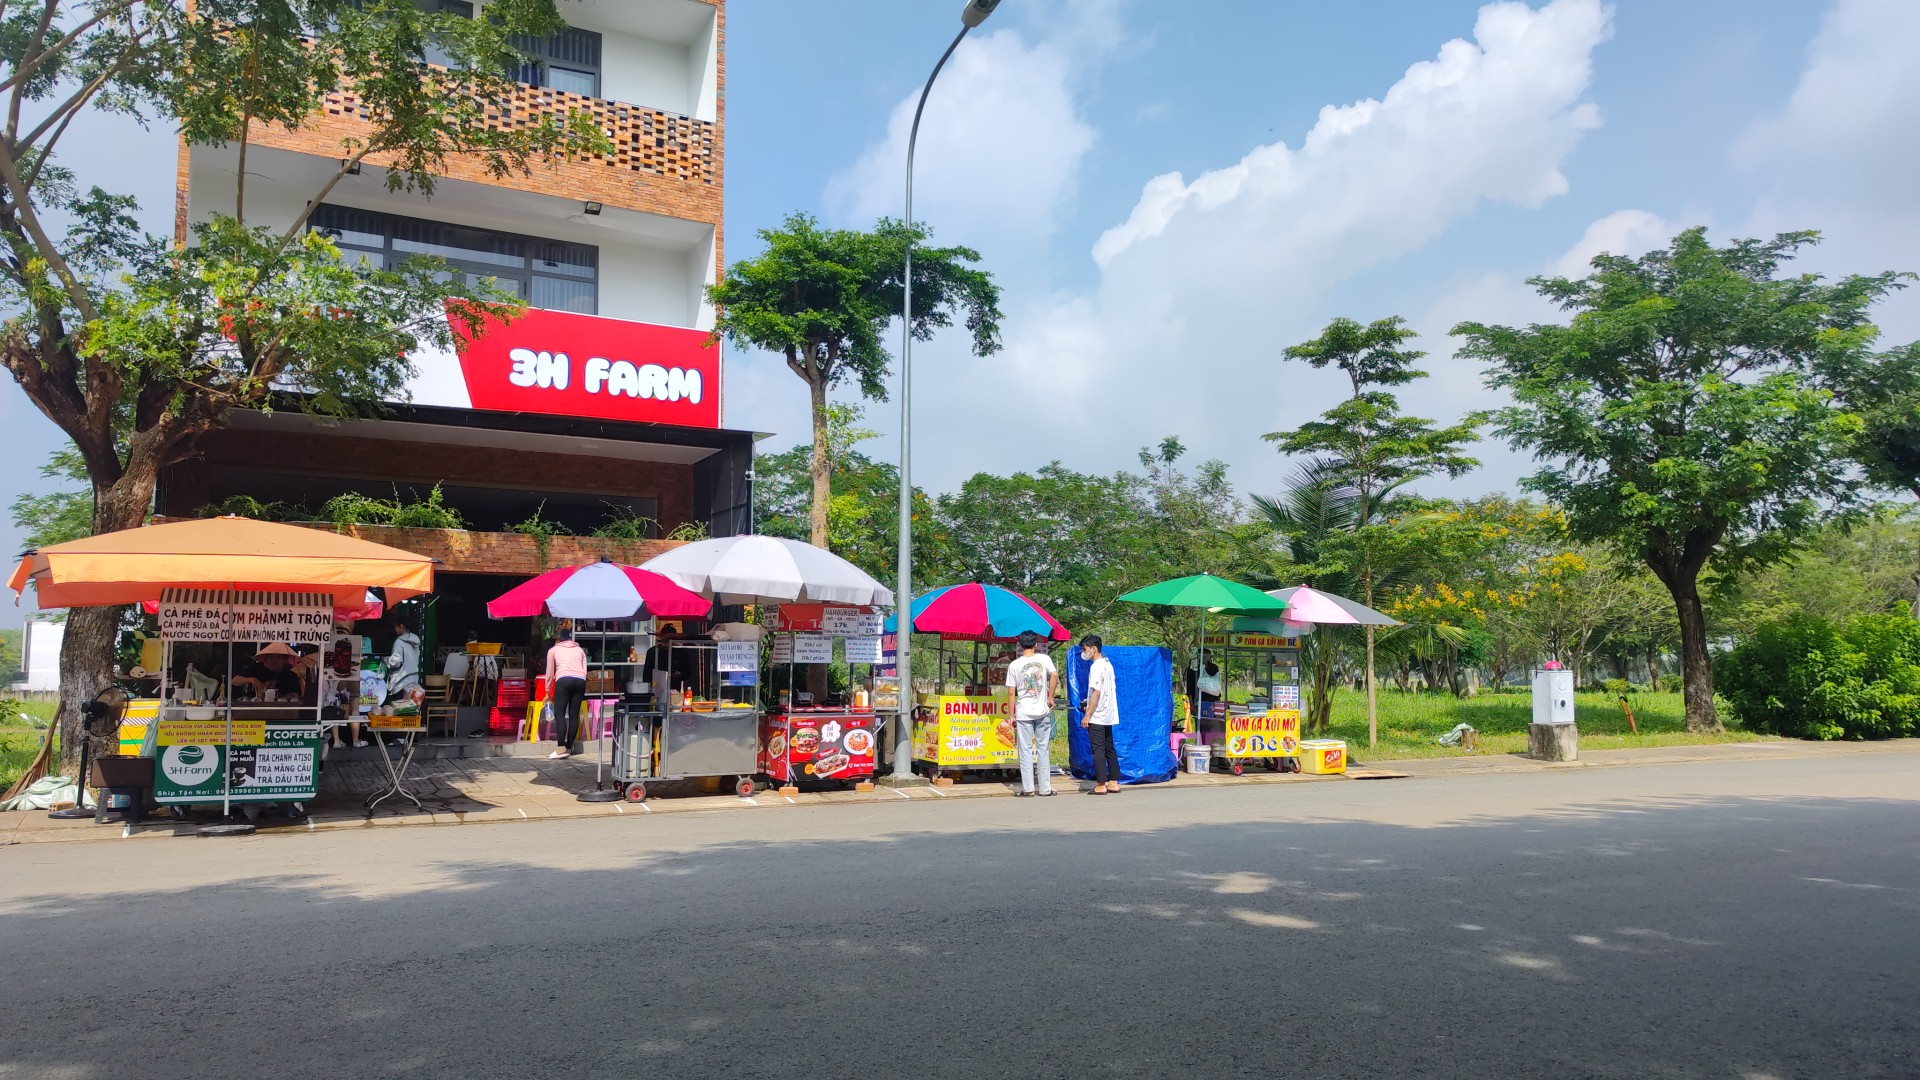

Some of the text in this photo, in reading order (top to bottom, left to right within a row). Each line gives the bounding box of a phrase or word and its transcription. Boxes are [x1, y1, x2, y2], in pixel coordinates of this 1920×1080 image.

[509, 348, 703, 405] 3H FARM
[164, 606, 221, 619] CÀ PHÊ ĐÁ
[249, 609, 277, 625] PHẦN
[278, 610, 331, 626] MÌ TRỘN
[163, 620, 173, 629] CÀ
[175, 620, 190, 629] PHÊ
[209, 619, 220, 630] ĐÁ
[163, 630, 219, 641] NƯỚC NGỌT
[252, 628, 276, 641] PHÒNG
[277, 629, 330, 642] MÌ TRỨNG
[945, 700, 978, 715] BÁNH
[982, 700, 997, 715] MÌ
[273, 731, 318, 739] COFFEE
[953, 739, 979, 747] 15.000
[1250, 734, 1278, 752] Bé
[259, 751, 312, 762] TRÀ CHANH ATISO
[168, 766, 212, 775] 3H Farm
[258, 763, 272, 773] TRÀ
[257, 774, 272, 783] TRÀ
